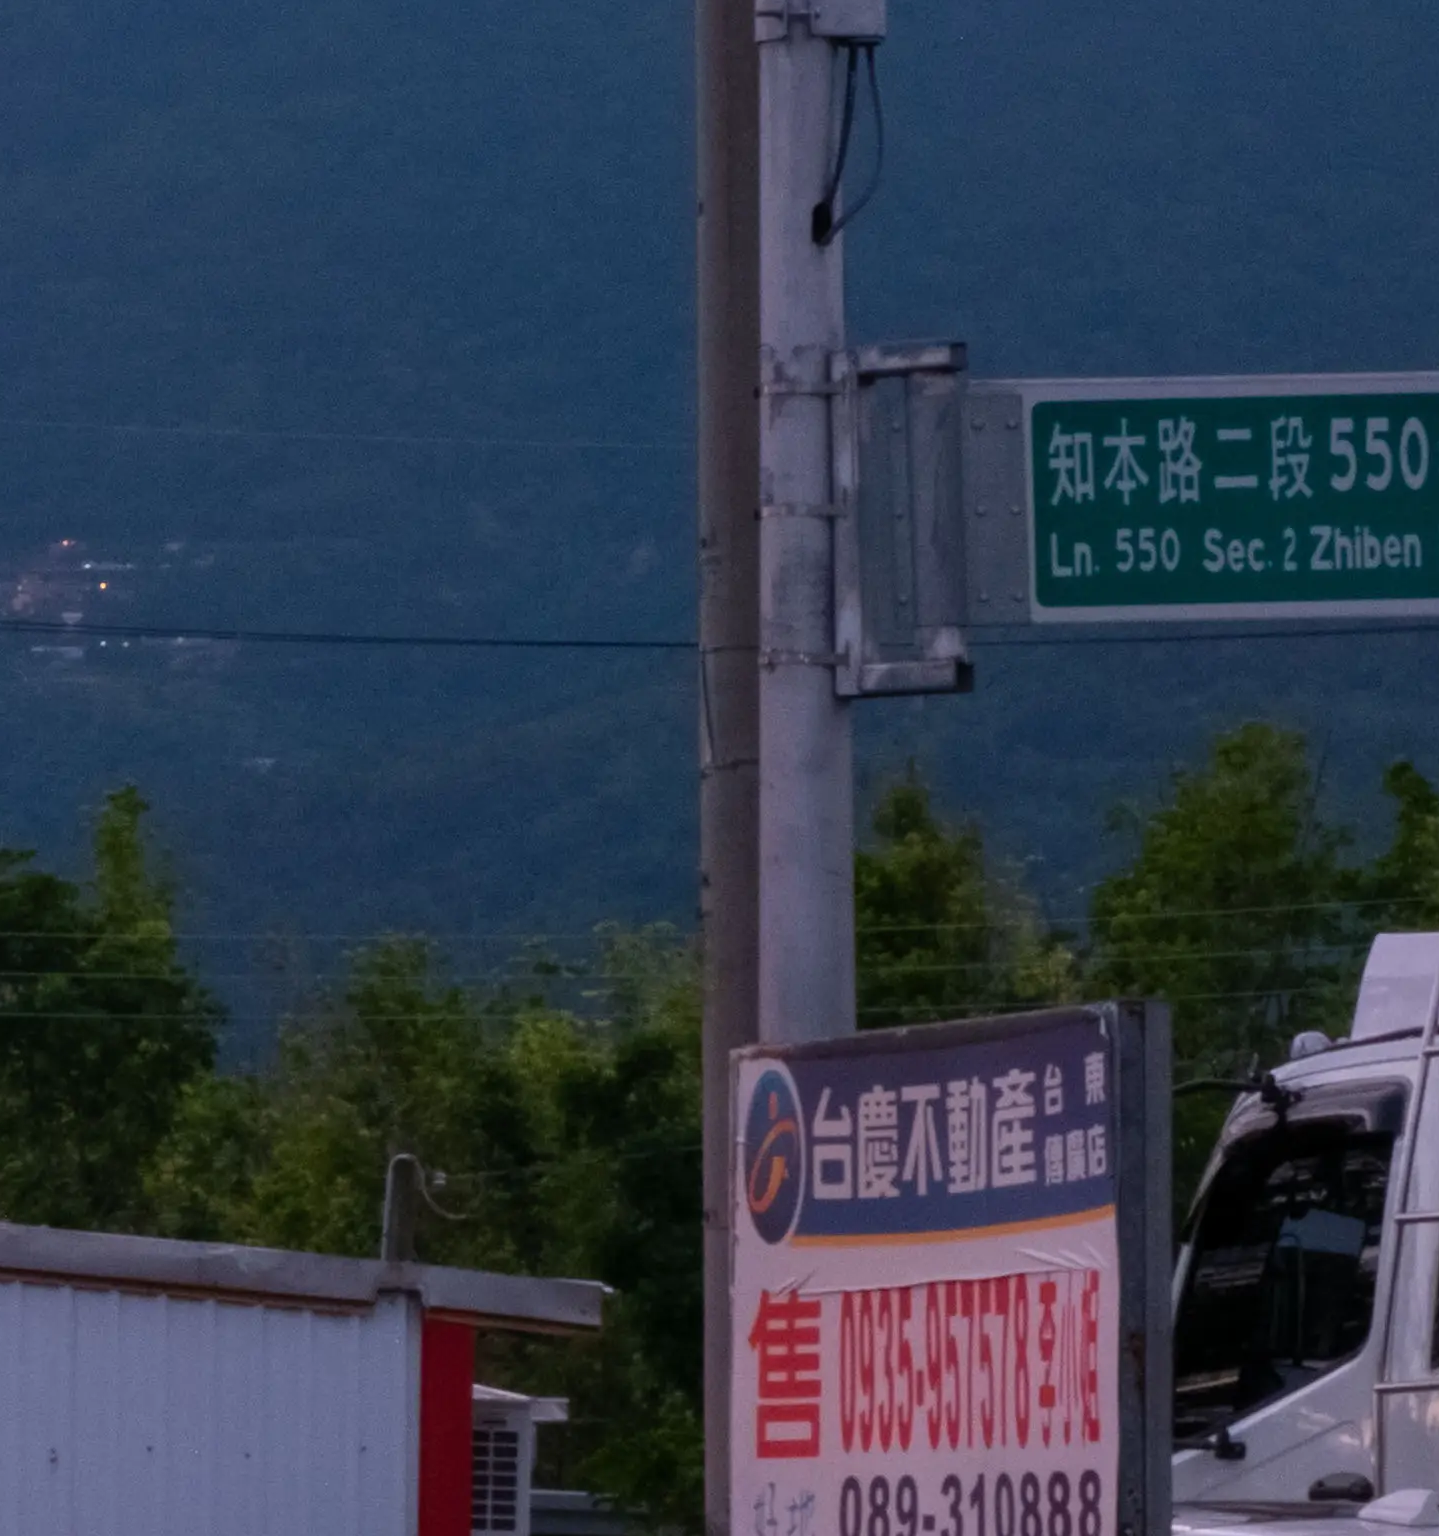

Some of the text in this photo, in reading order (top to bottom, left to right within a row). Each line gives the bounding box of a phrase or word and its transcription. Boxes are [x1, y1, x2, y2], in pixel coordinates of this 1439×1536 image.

[1050, 532, 1100, 578] Ln.
[1115, 527, 1181, 572] 550
[1310, 524, 1422, 570] Zhiben
[812, 1067, 1038, 1201] 台慶不動產
[1043, 1051, 1106, 1116] 台東
[747, 1289, 822, 1459] 售
[839, 1272, 1031, 1453] 0935-957578
